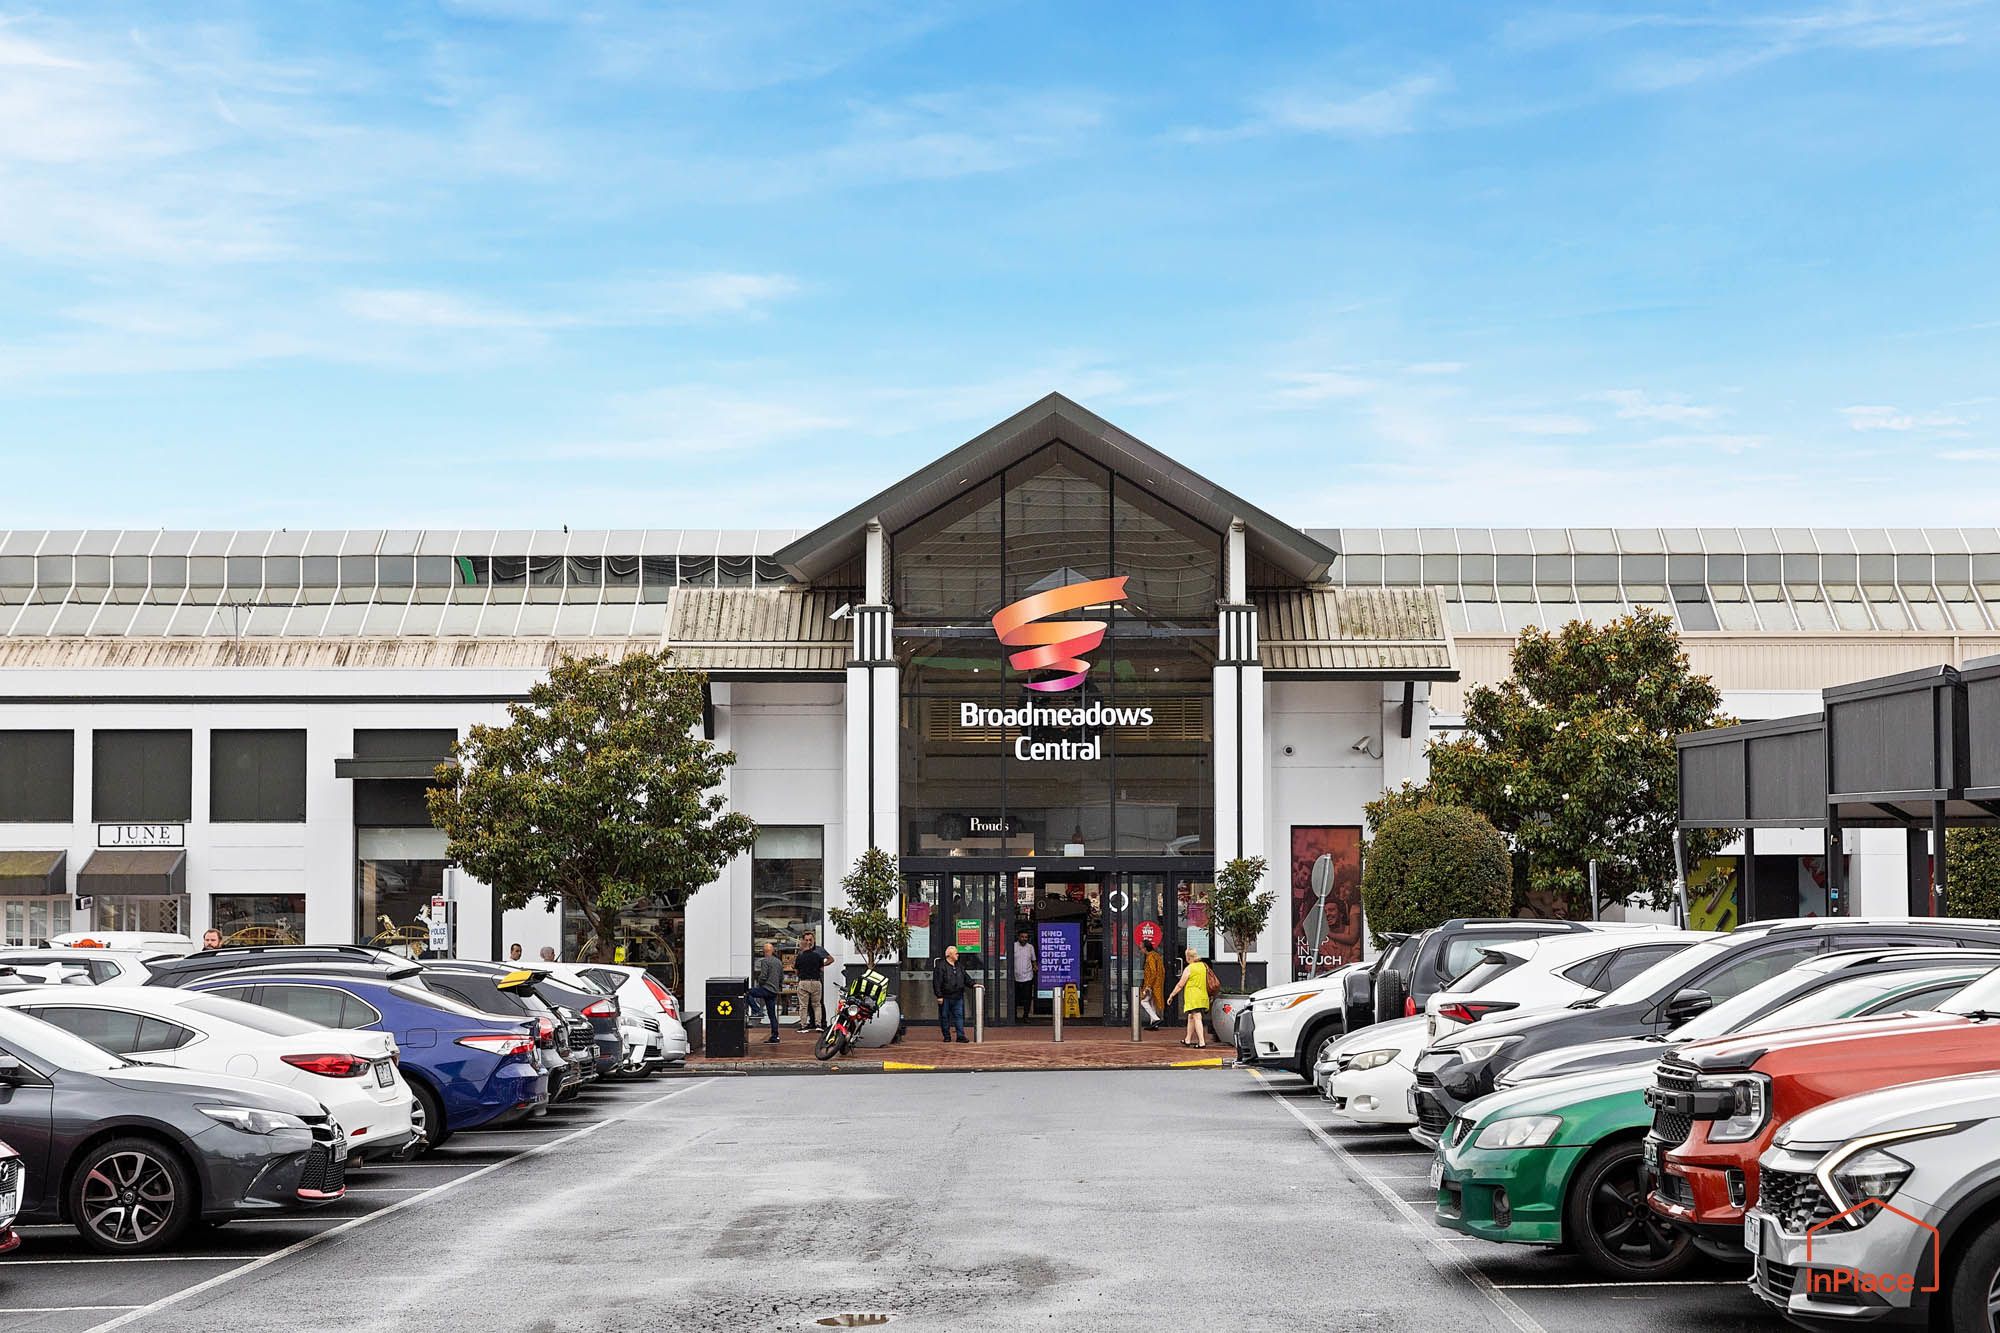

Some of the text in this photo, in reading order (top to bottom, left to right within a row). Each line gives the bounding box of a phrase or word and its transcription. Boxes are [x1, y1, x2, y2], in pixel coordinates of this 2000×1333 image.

[960, 701, 1154, 727] Broadmeadows
[1014, 735, 1101, 761] Central
[970, 817, 1009, 832] Prouds
[112, 826, 170, 844] JUNE
[1298, 936, 1330, 945] KP
[1298, 946, 1310, 955] IN
[1298, 956, 1342, 965] TOUCH
